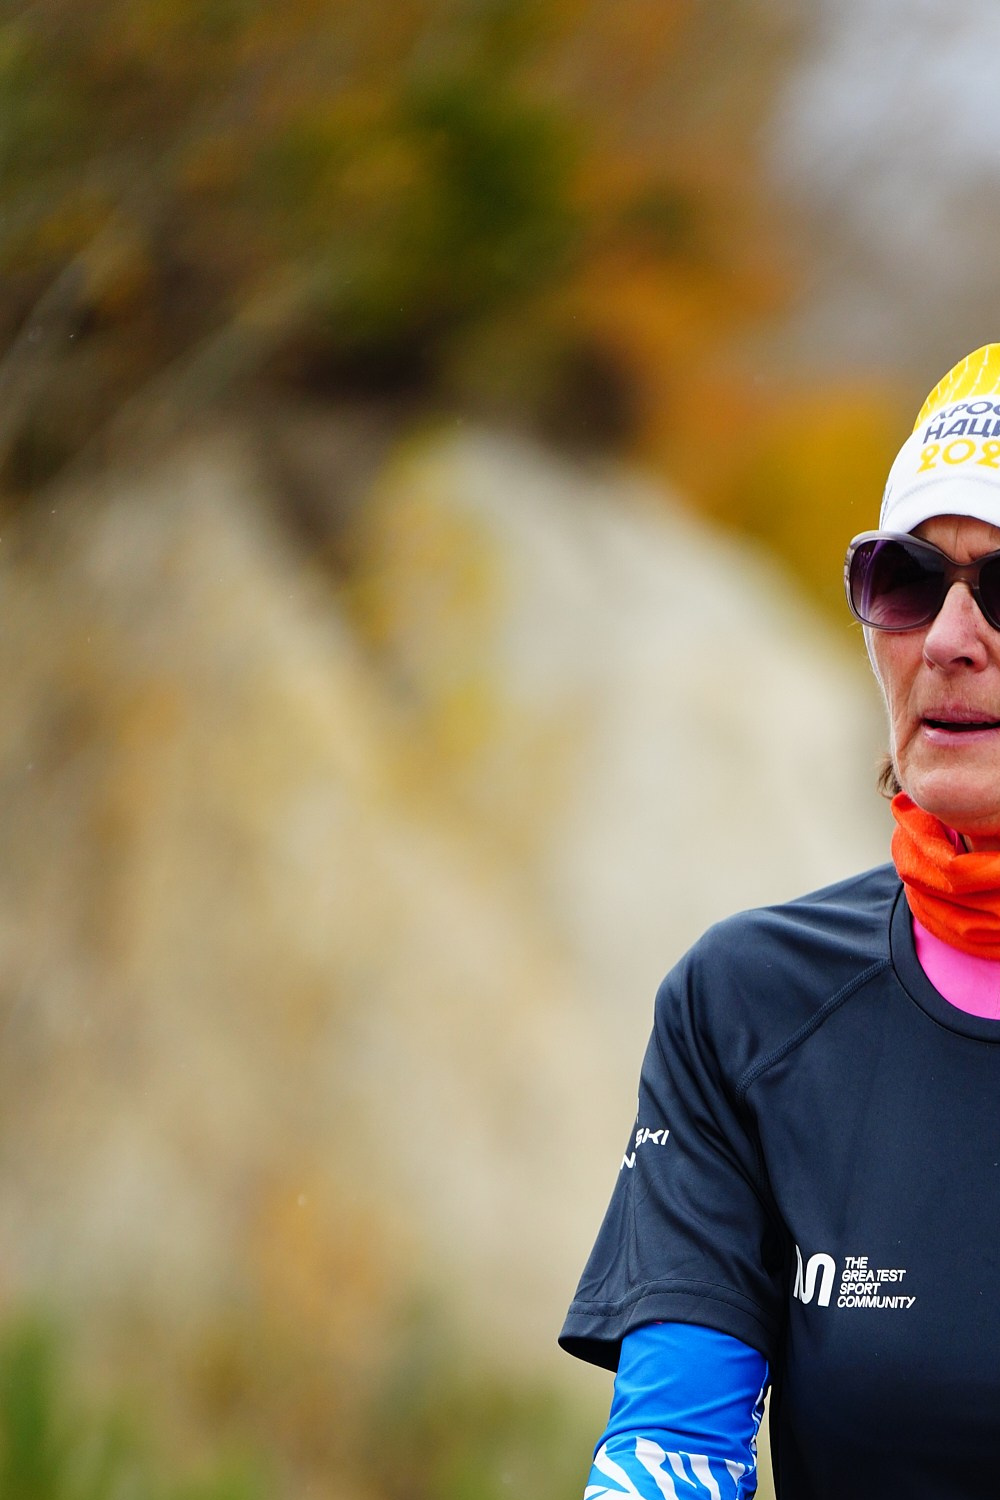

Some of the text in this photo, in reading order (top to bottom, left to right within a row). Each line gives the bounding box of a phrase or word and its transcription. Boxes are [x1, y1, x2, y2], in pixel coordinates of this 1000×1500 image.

[844, 1256, 869, 1269] THE
[841, 1269, 907, 1282] GREATEST
[839, 1282, 881, 1295] SPORT
[837, 1295, 916, 1309] COMMUNITY
